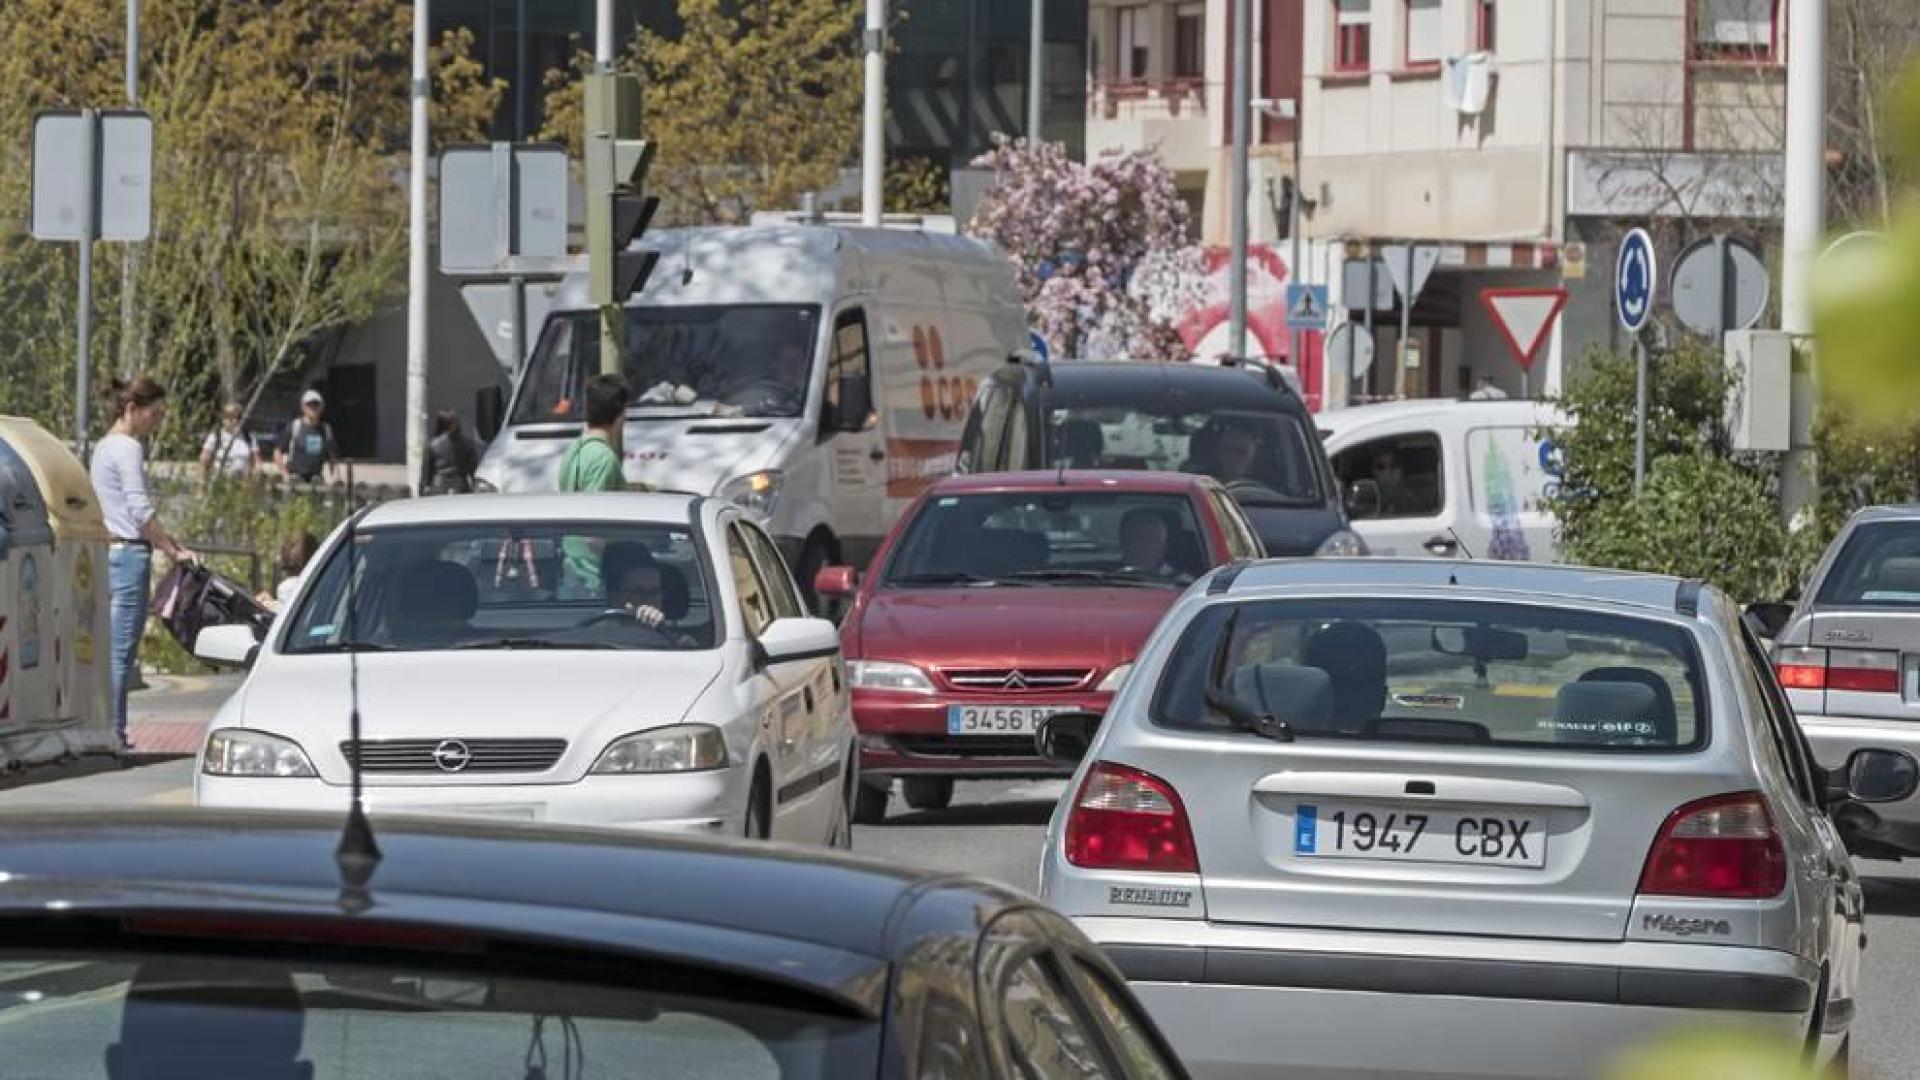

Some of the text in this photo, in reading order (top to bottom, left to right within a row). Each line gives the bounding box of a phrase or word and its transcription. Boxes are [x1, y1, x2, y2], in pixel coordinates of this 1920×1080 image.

[965, 709, 1023, 730] 3456
[1334, 811, 1530, 859] 1947 CBX
[1110, 886, 1192, 906] RENAULT
